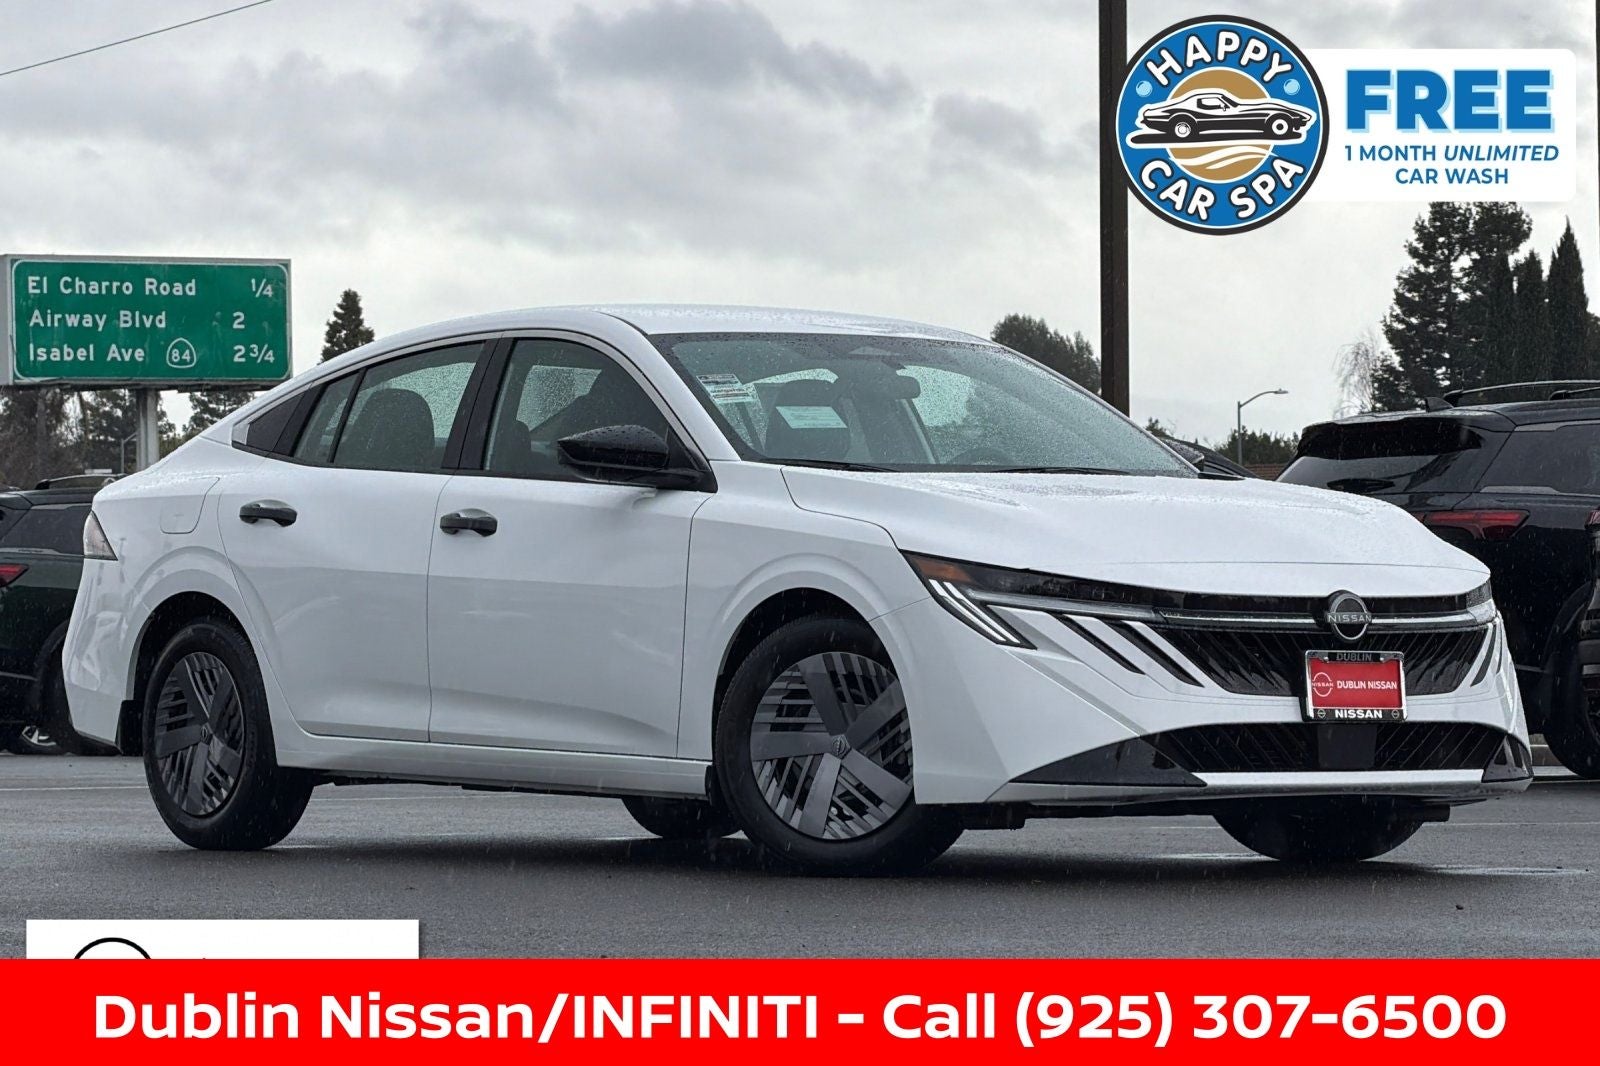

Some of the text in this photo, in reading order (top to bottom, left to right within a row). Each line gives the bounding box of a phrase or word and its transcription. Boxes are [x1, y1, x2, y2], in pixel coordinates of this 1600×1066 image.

[27, 276, 48, 294] El
[59, 277, 133, 295] Charro
[145, 278, 196, 296] Road
[29, 309, 245, 331] Airway Blvd 2
[29, 344, 94, 361] Isabel
[106, 344, 145, 362] Ave
[171, 349, 191, 362] 84
[1327, 614, 1372, 623] NISSAN
[1336, 652, 1372, 662] DUBLIN
[1337, 680, 1397, 689] DUBLIN NISSAN
[1335, 709, 1383, 719] NISSAN
